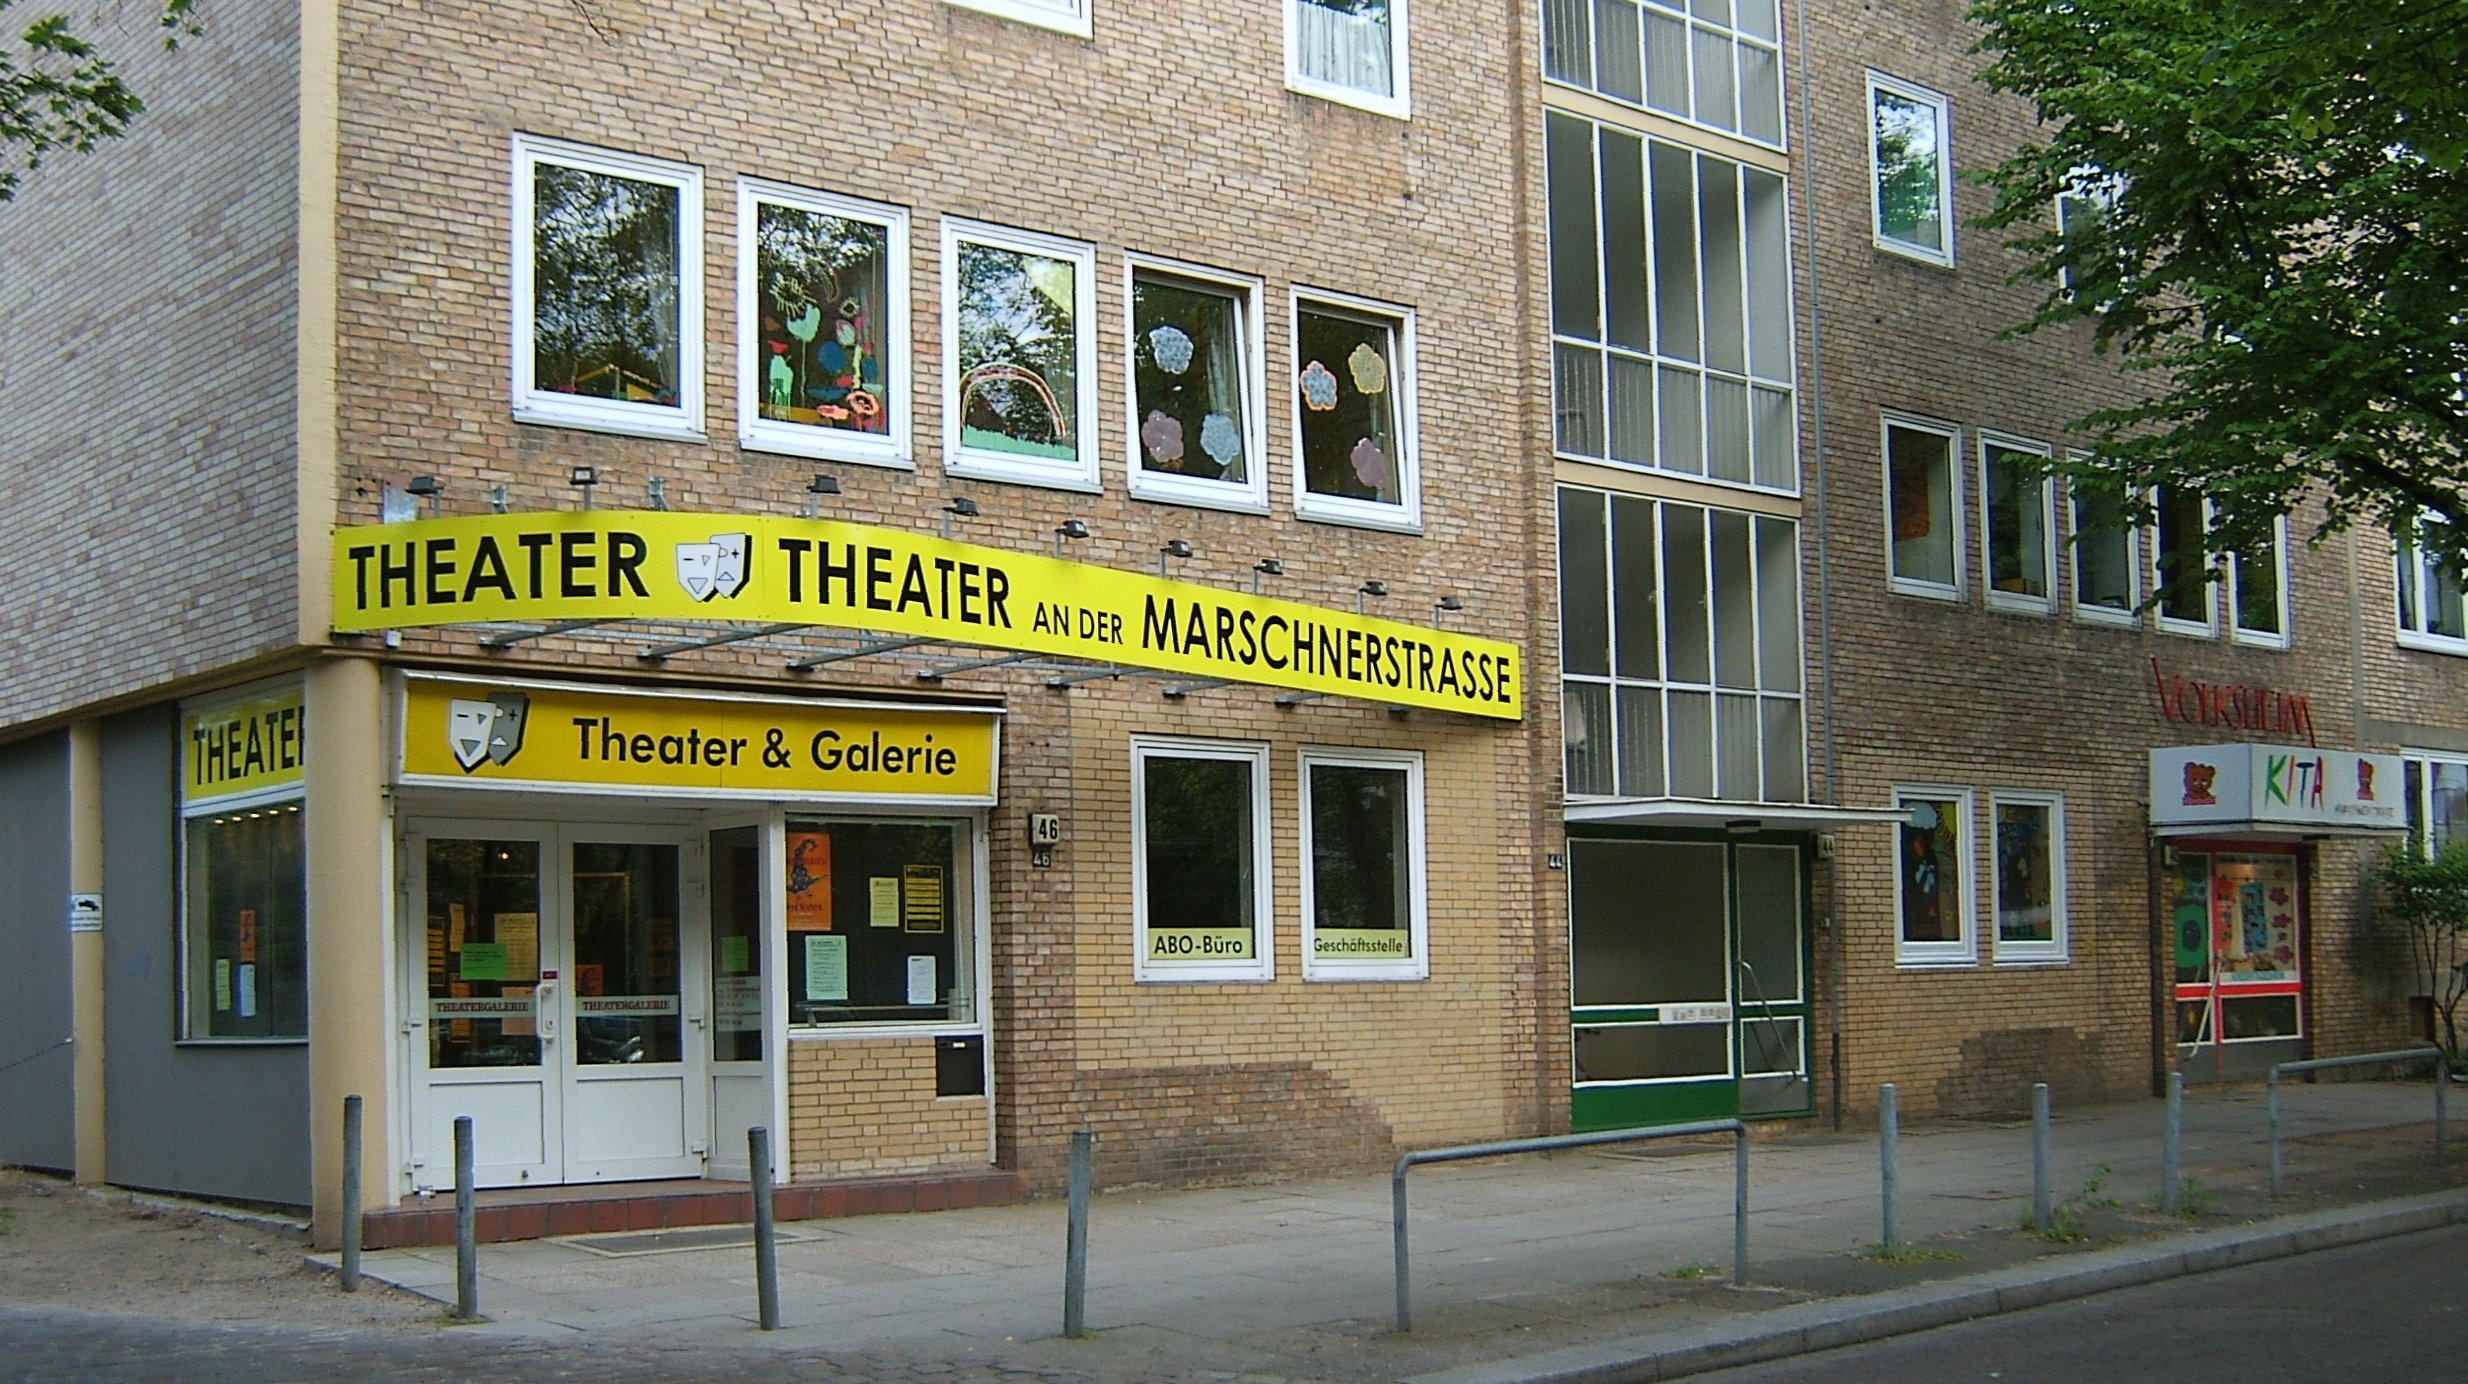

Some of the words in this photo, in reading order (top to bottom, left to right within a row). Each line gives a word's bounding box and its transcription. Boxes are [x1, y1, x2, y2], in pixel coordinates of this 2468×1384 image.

[348, 531, 650, 610] THEATER
[778, 538, 1012, 628] THEATER
[1032, 601, 1070, 637] AN
[1079, 608, 1123, 645] DER
[1141, 593, 1511, 704] MARSCHNERSTRASSE
[2151, 658, 2316, 748] VOLKSHEIM
[572, 717, 748, 767] Theater
[761, 727, 792, 769] &
[810, 729, 957, 776] Galerie
[2264, 754, 2324, 812] KITA
[1038, 818, 1058, 840] 46
[1033, 851, 1050, 867] 46
[1154, 935, 1243, 954] ABO-Büro
[1313, 937, 1403, 953] Geschäftsstelle
[436, 1002, 529, 1012] THEATERGALERIE
[583, 1001, 670, 1011] THEATERGALERIE
